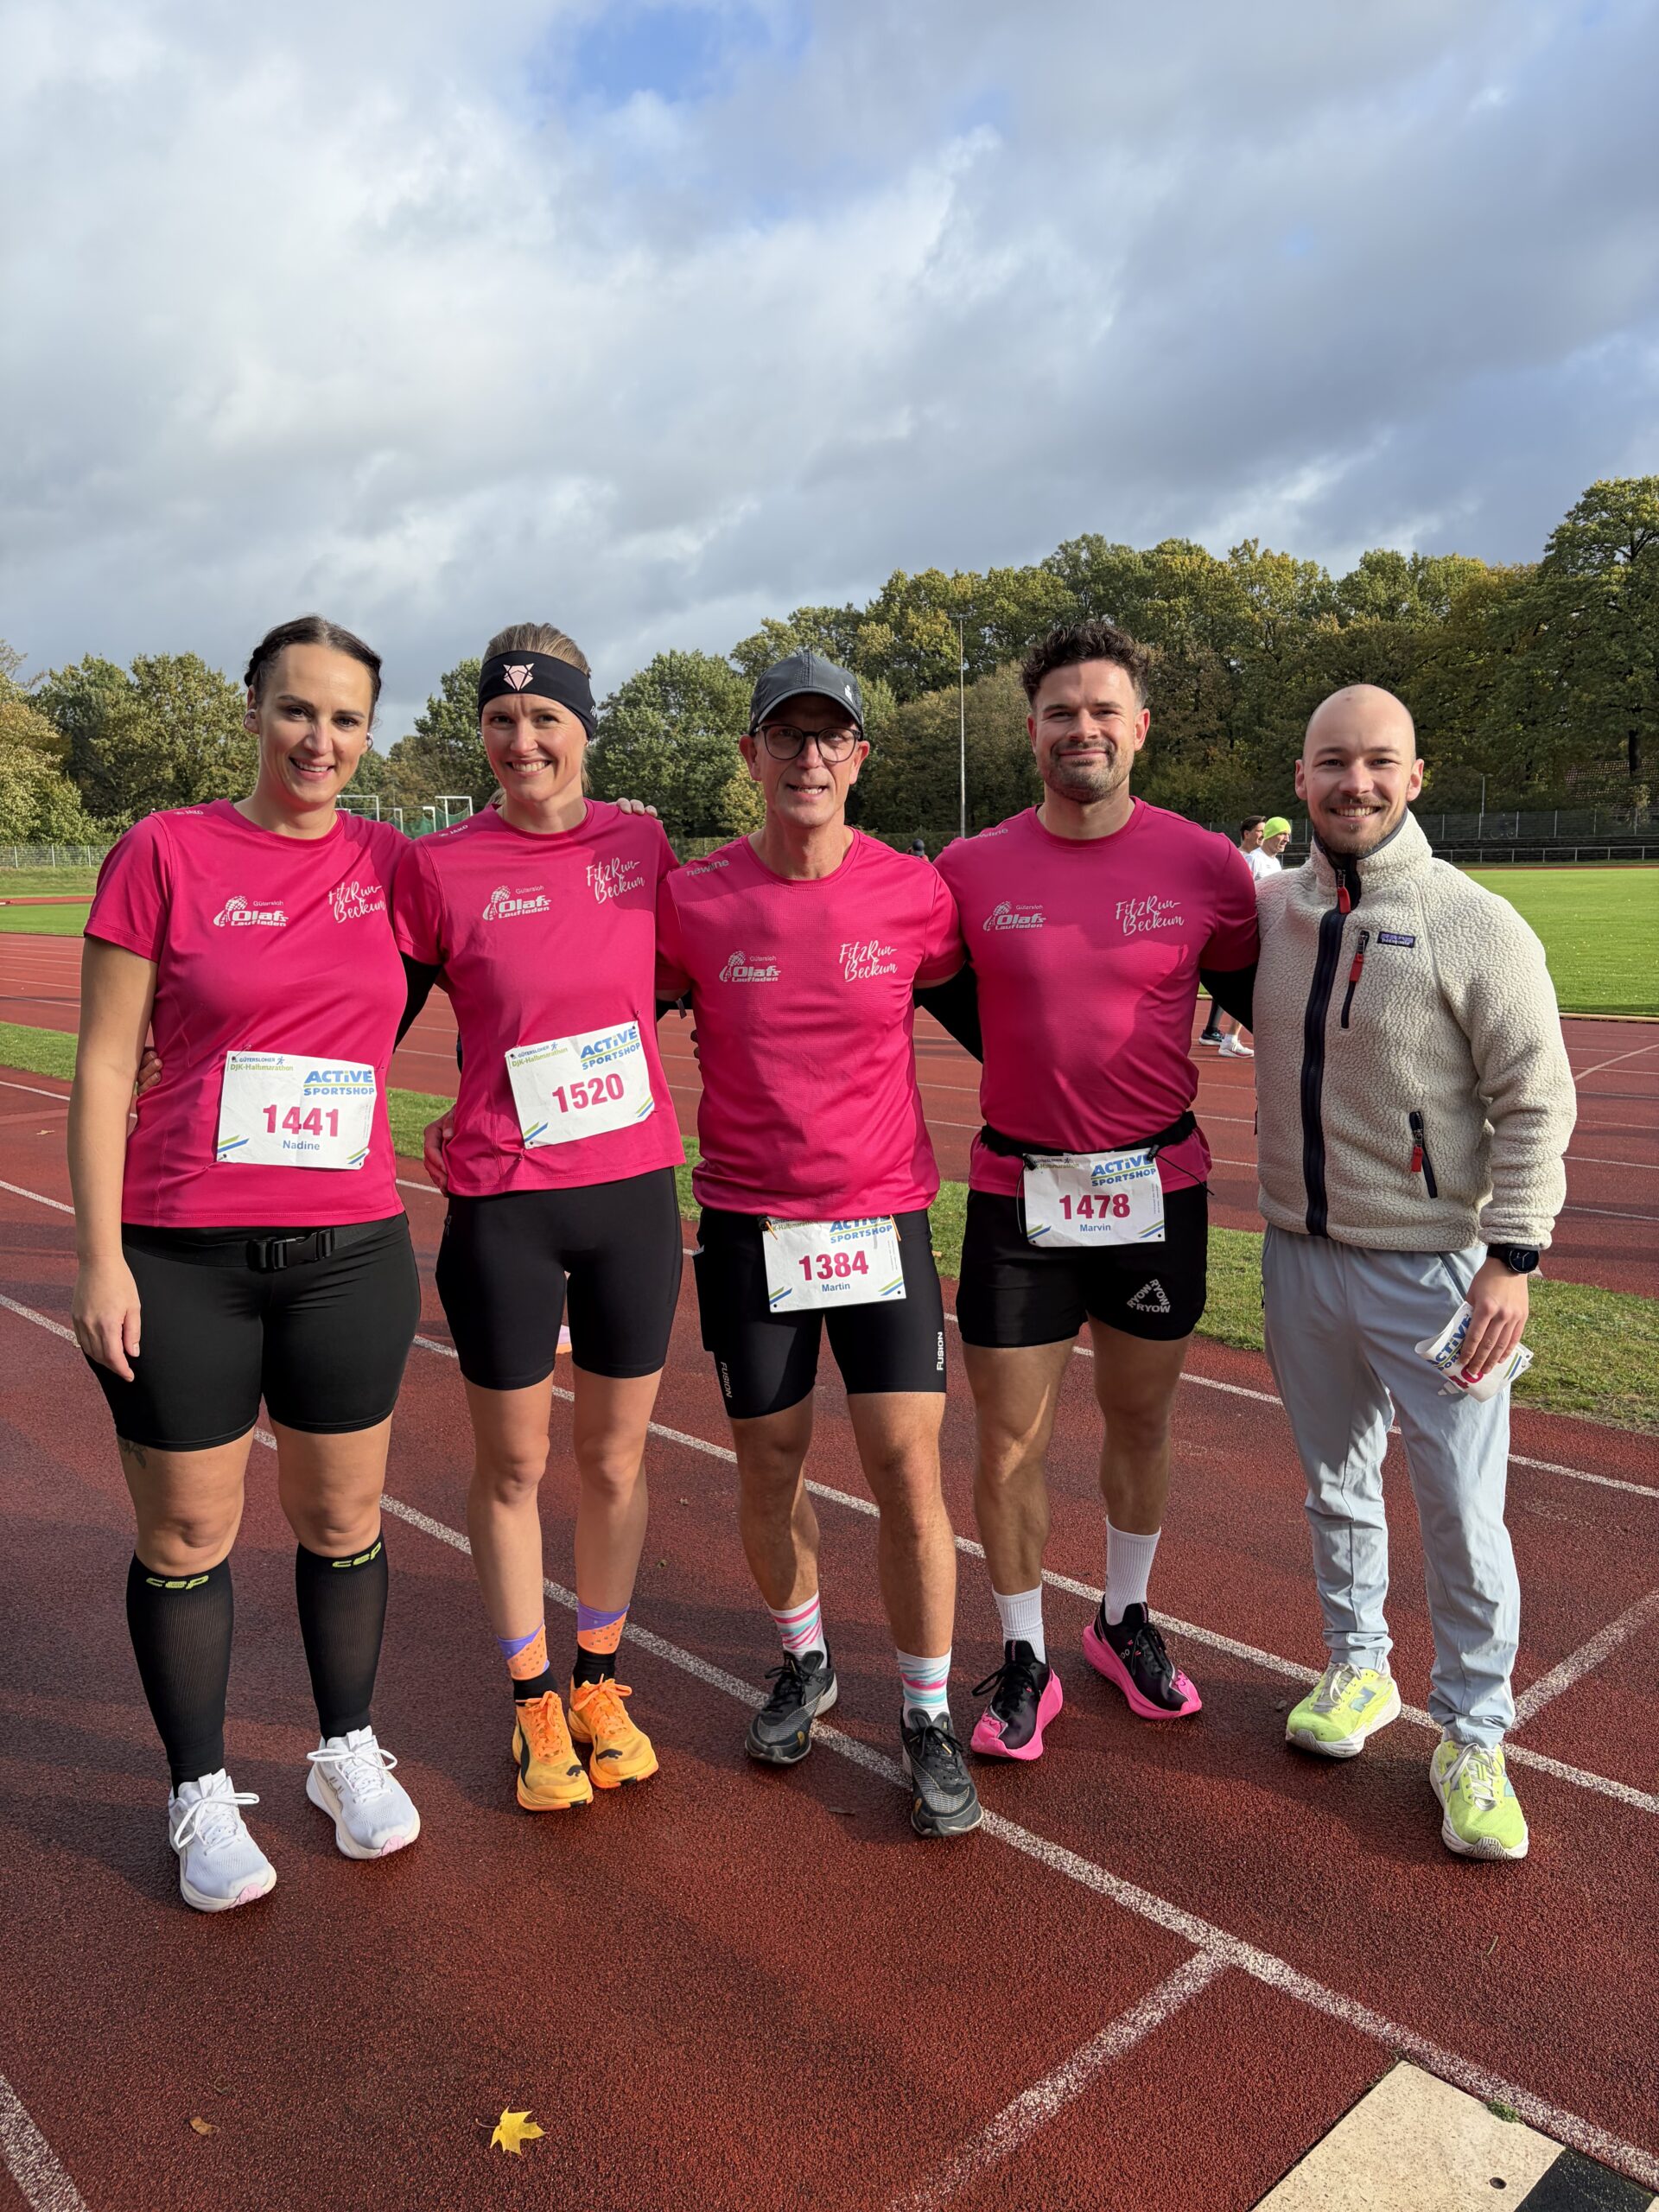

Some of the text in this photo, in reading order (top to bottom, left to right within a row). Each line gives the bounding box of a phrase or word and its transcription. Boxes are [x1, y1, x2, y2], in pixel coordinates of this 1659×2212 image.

[594, 874, 645, 905] Beckum
[232, 910, 289, 922] Olafs
[334, 898, 386, 924] Beckum
[499, 895, 552, 912] Olafs
[996, 912, 1046, 925] Olafs
[1123, 910, 1185, 937] Beckum
[733, 965, 781, 976] Olafs
[844, 957, 899, 982] Beckum
[582, 1042, 641, 1071] SPORTSHOP
[304, 1087, 375, 1096] SPORTSHOP
[552, 1073, 625, 1113] 1520
[263, 1104, 339, 1137] 1441
[283, 1140, 321, 1151] Nadine
[1092, 1168, 1156, 1187] SPORTSHOP
[1059, 1193, 1131, 1220] 1478
[830, 1224, 893, 1244] SPORTSHOP
[1080, 1223, 1111, 1232] Marvin
[798, 1250, 869, 1281] 1384
[822, 1282, 850, 1293] Martin
[936, 1331, 944, 1371] FUSION
[720, 1361, 733, 1399] FUSION
